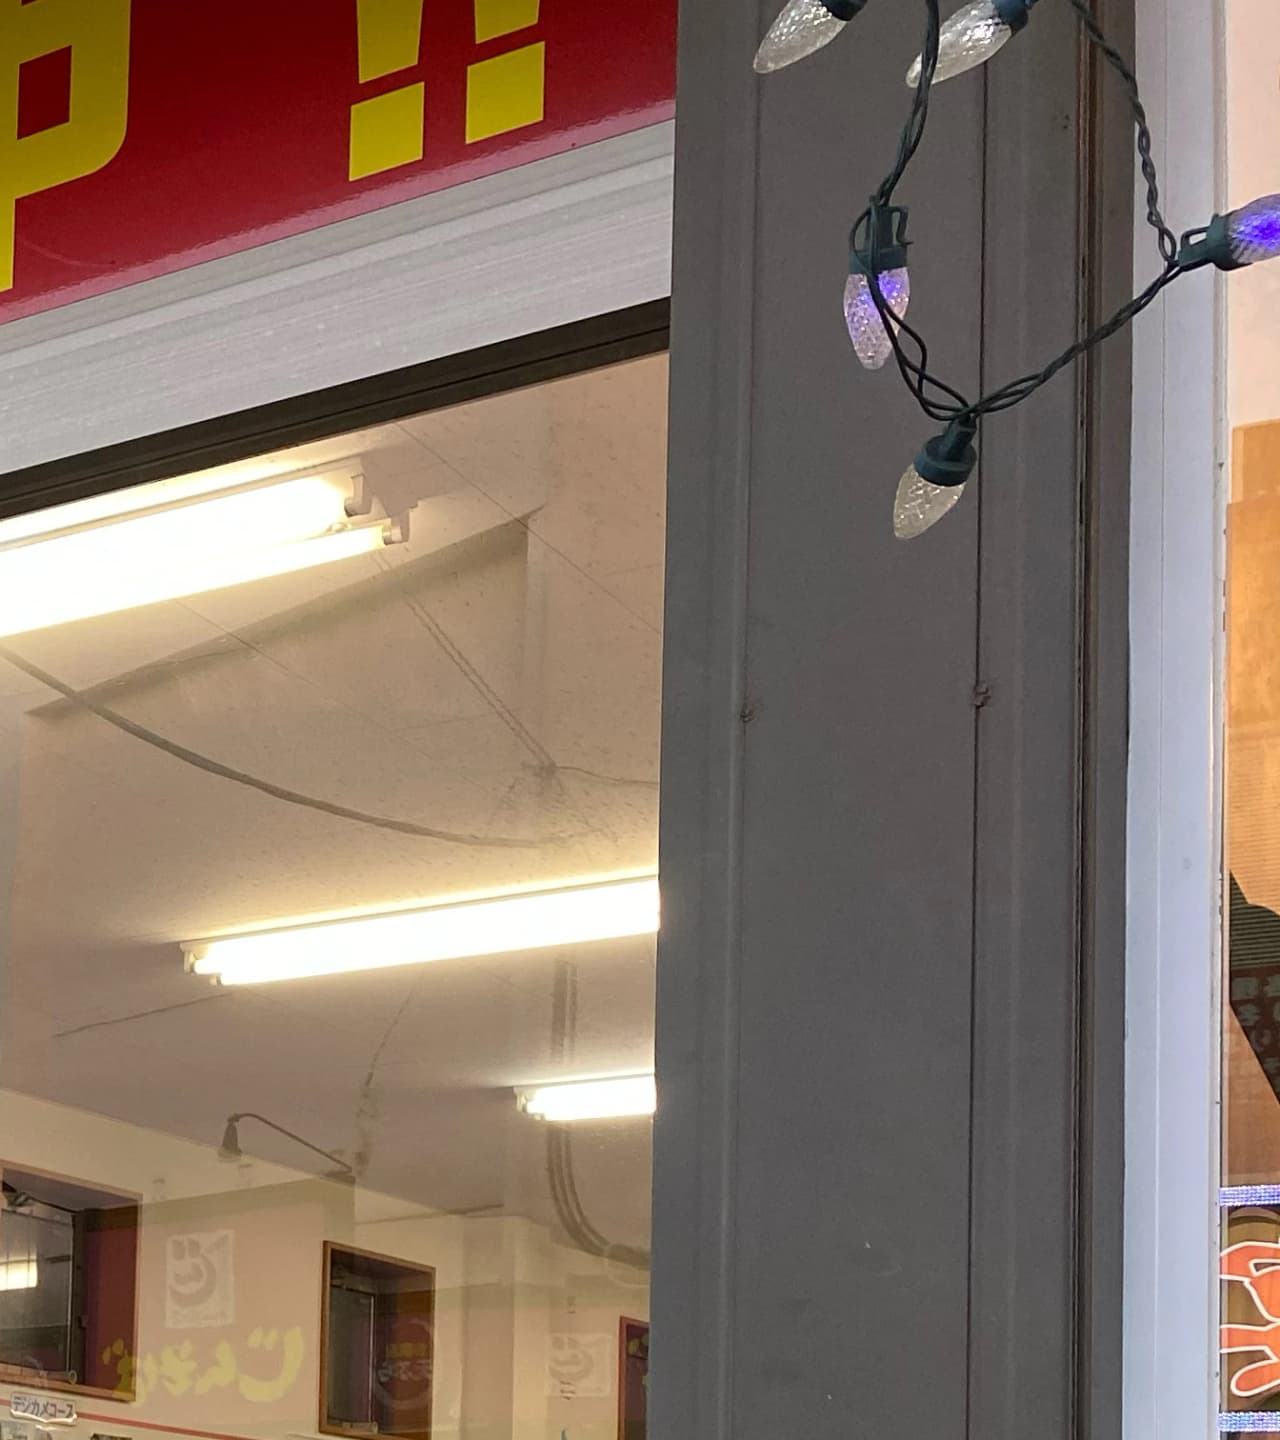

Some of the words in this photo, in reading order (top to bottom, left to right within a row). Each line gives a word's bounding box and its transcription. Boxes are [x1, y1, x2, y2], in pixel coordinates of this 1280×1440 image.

[12, 1395, 75, 1417] デジカメコース
